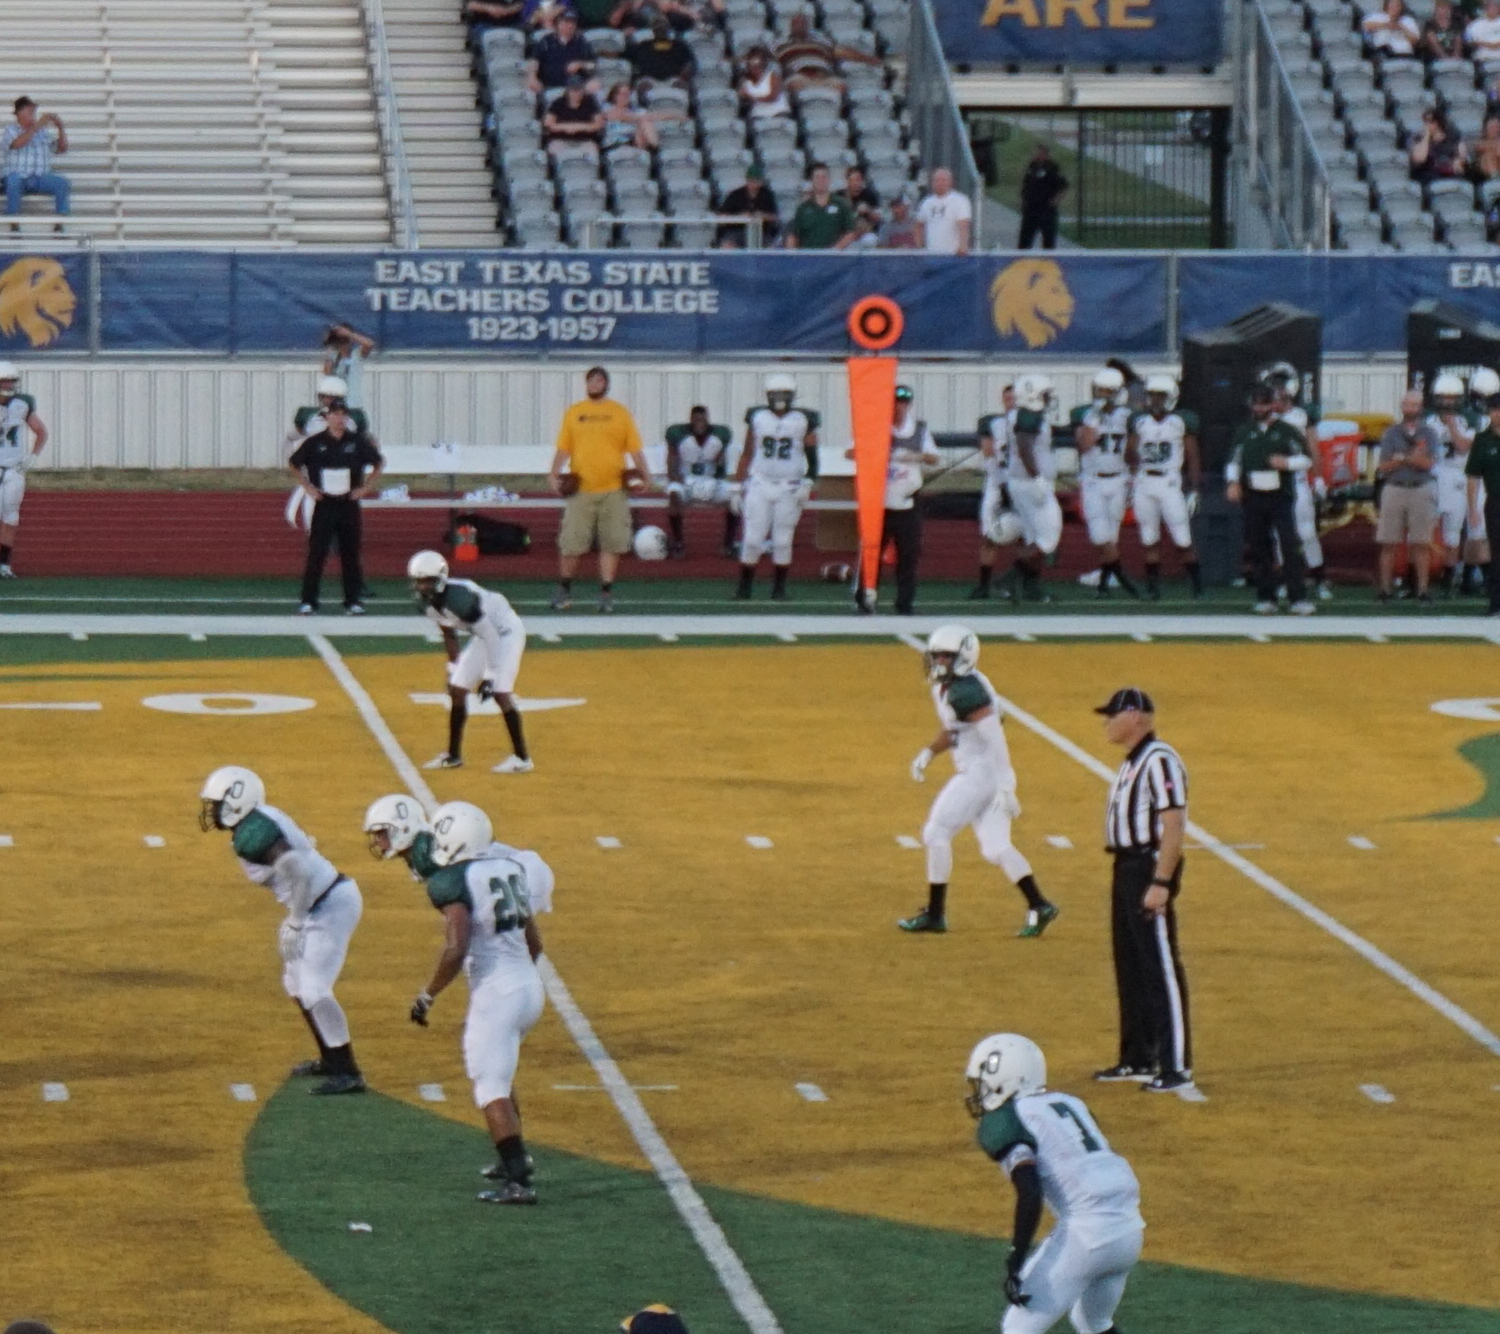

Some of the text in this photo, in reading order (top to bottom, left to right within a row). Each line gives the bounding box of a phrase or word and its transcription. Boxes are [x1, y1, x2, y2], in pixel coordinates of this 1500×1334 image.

[375, 261, 711, 287] EAST TEXAS STATE
[366, 288, 720, 314] TEACHERS COLLEGE
[467, 317, 617, 342] 1923-1957
[761, 436, 793, 460] 92
